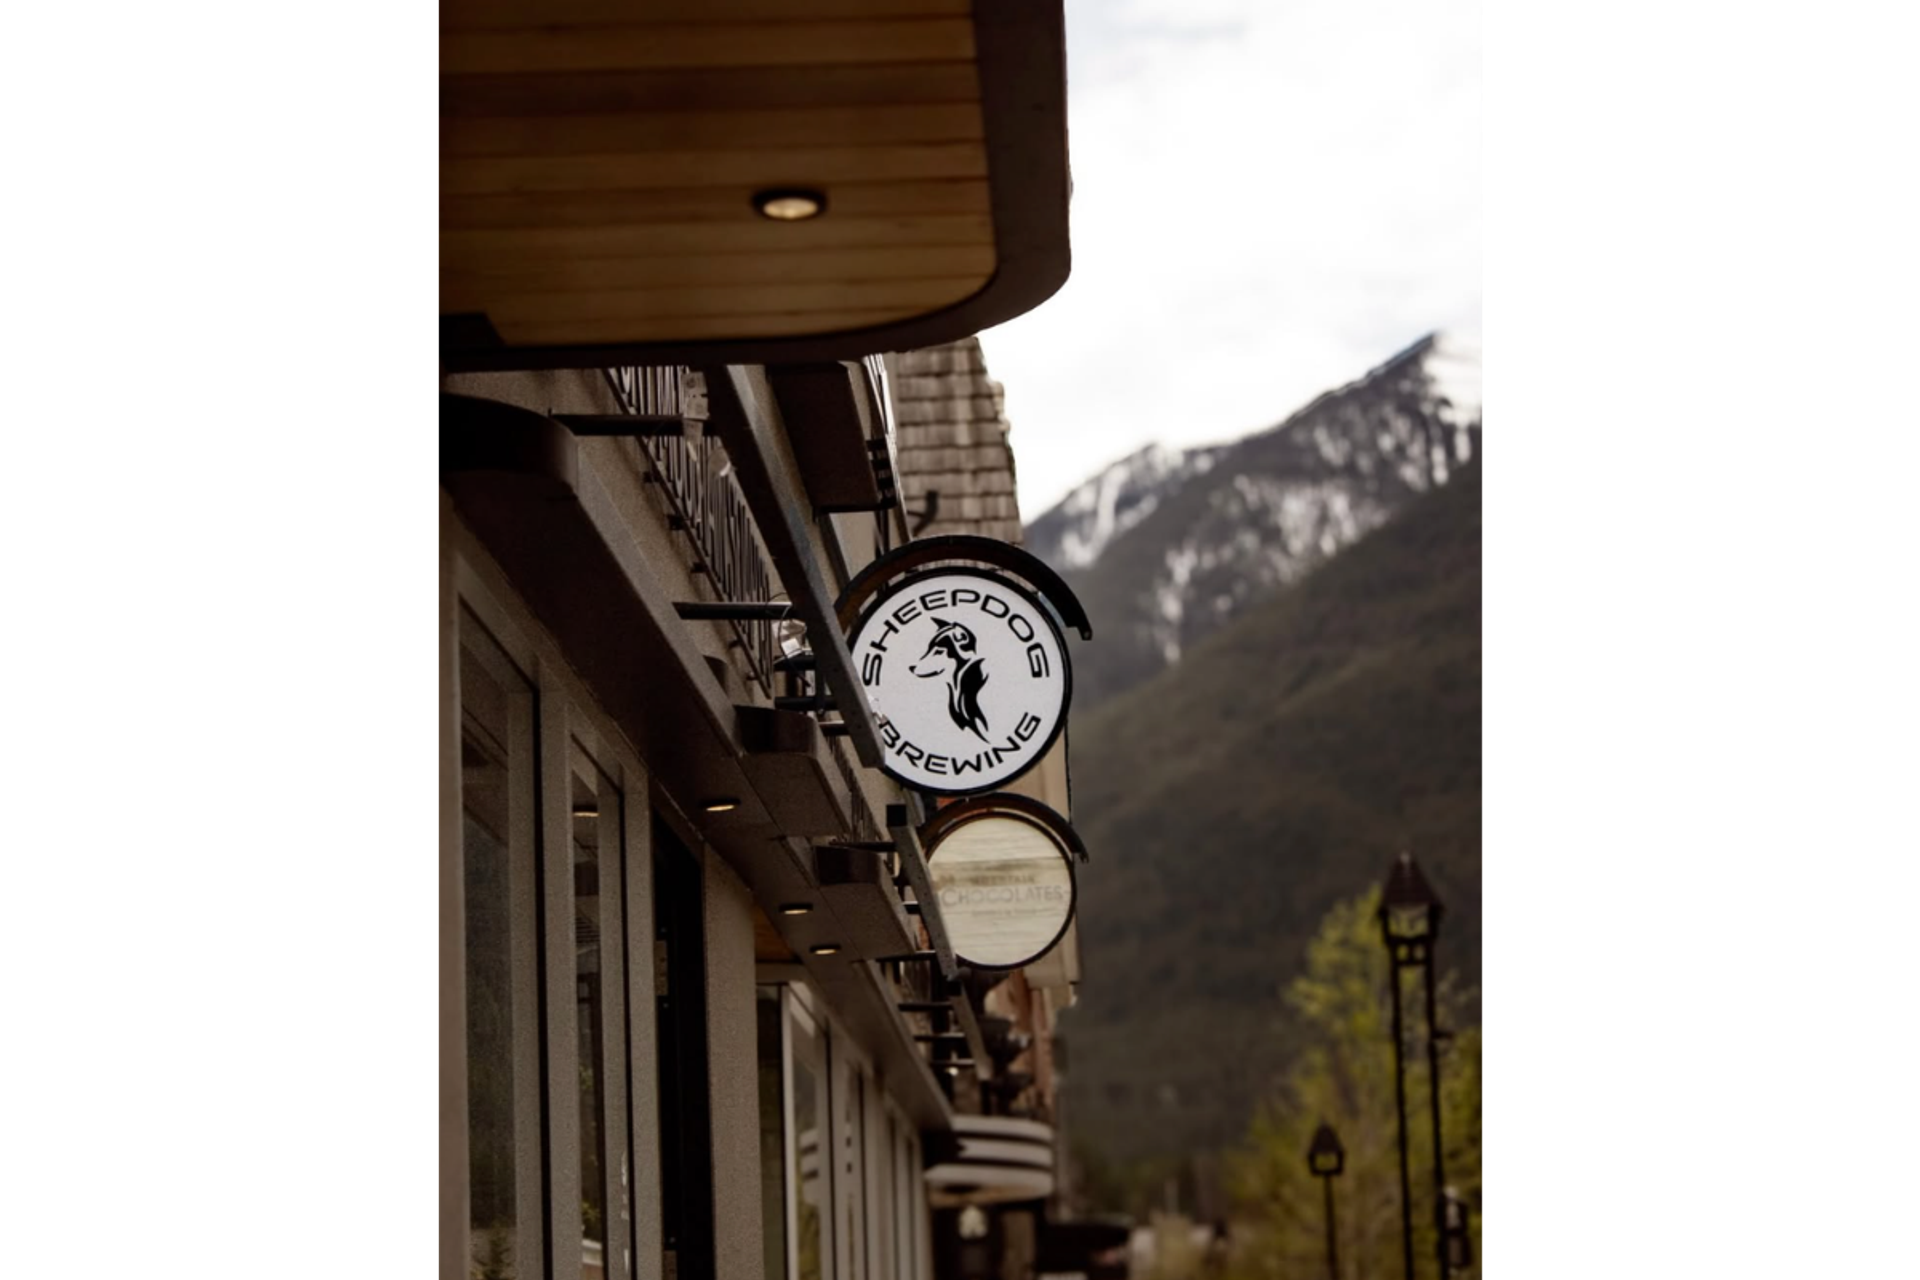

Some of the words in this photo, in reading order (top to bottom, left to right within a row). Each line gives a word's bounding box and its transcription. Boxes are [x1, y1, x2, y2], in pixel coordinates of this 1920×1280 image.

[862, 588, 1050, 686] SHEEPDOG
[878, 712, 1042, 775] BREWING
[941, 885, 1064, 907] CHOCOLATES
